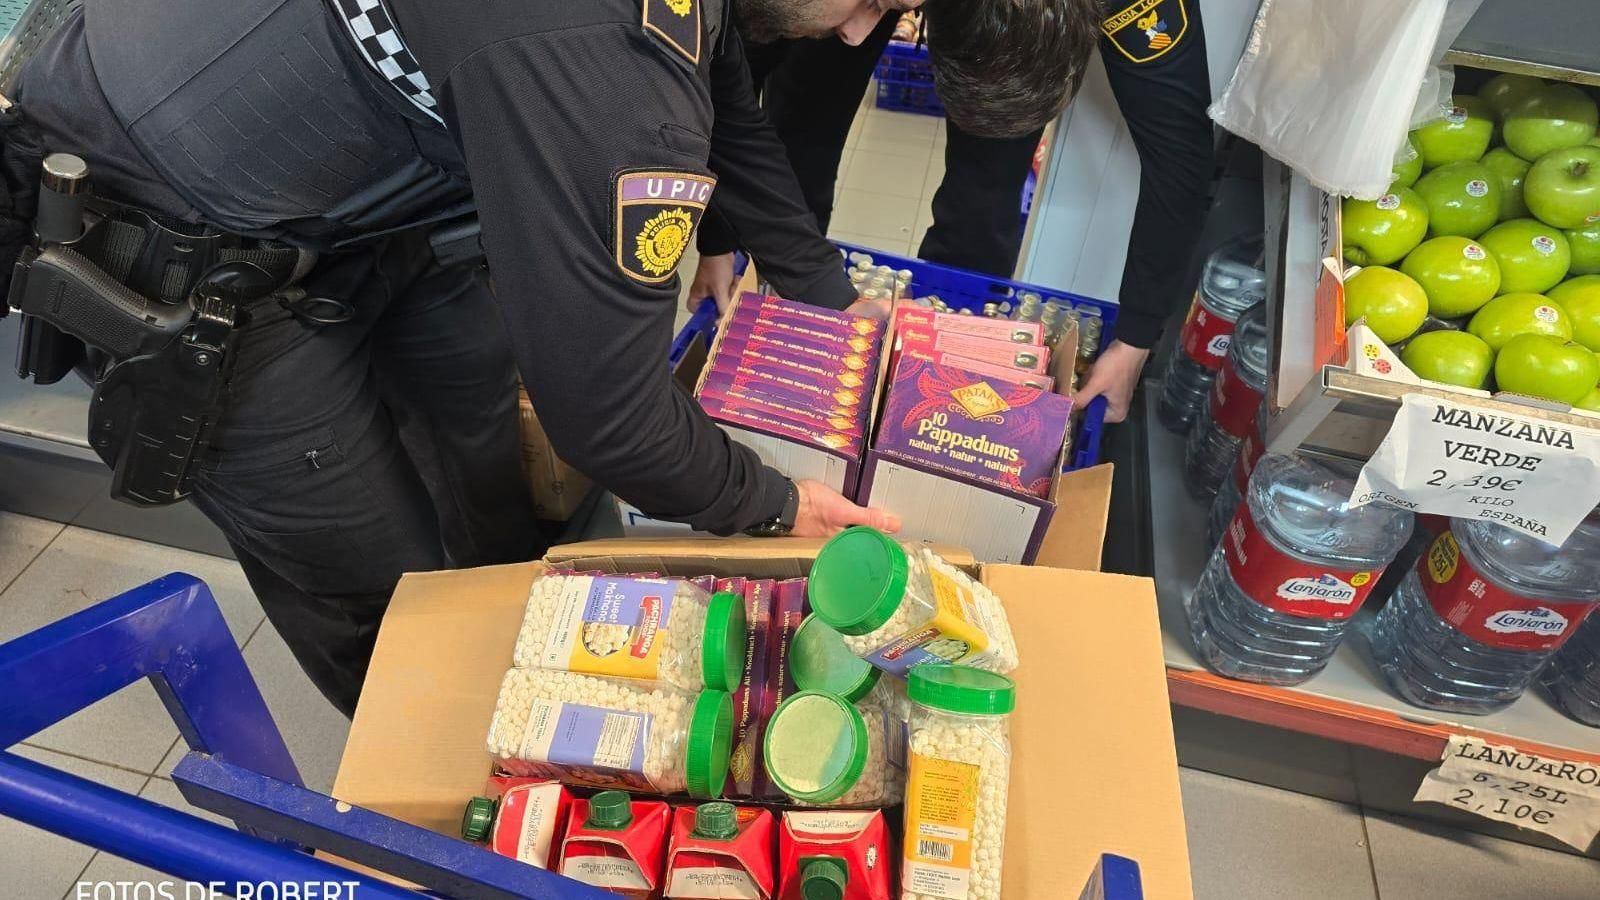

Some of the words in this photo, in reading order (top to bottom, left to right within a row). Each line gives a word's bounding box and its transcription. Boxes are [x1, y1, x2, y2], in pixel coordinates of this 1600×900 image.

[1106, 9, 1139, 31] POLICIA
[647, 178, 710, 201] UPIC
[933, 412, 948, 426] 10
[1431, 405, 1575, 450] MANZANA
[917, 418, 1019, 461] Pappadums
[909, 438, 942, 454] nature
[949, 449, 977, 463] natur
[984, 460, 1022, 476] naturel
[1444, 440, 1542, 472] VERDE
[1427, 469, 1522, 493] 2,39€
[1358, 491, 1419, 510] ORIGEN
[1467, 495, 1515, 507] KILO
[1478, 509, 1548, 537] ESPAÑA
[1455, 743, 1600, 787] LANJARO
[1453, 788, 1555, 825] 2,10€
